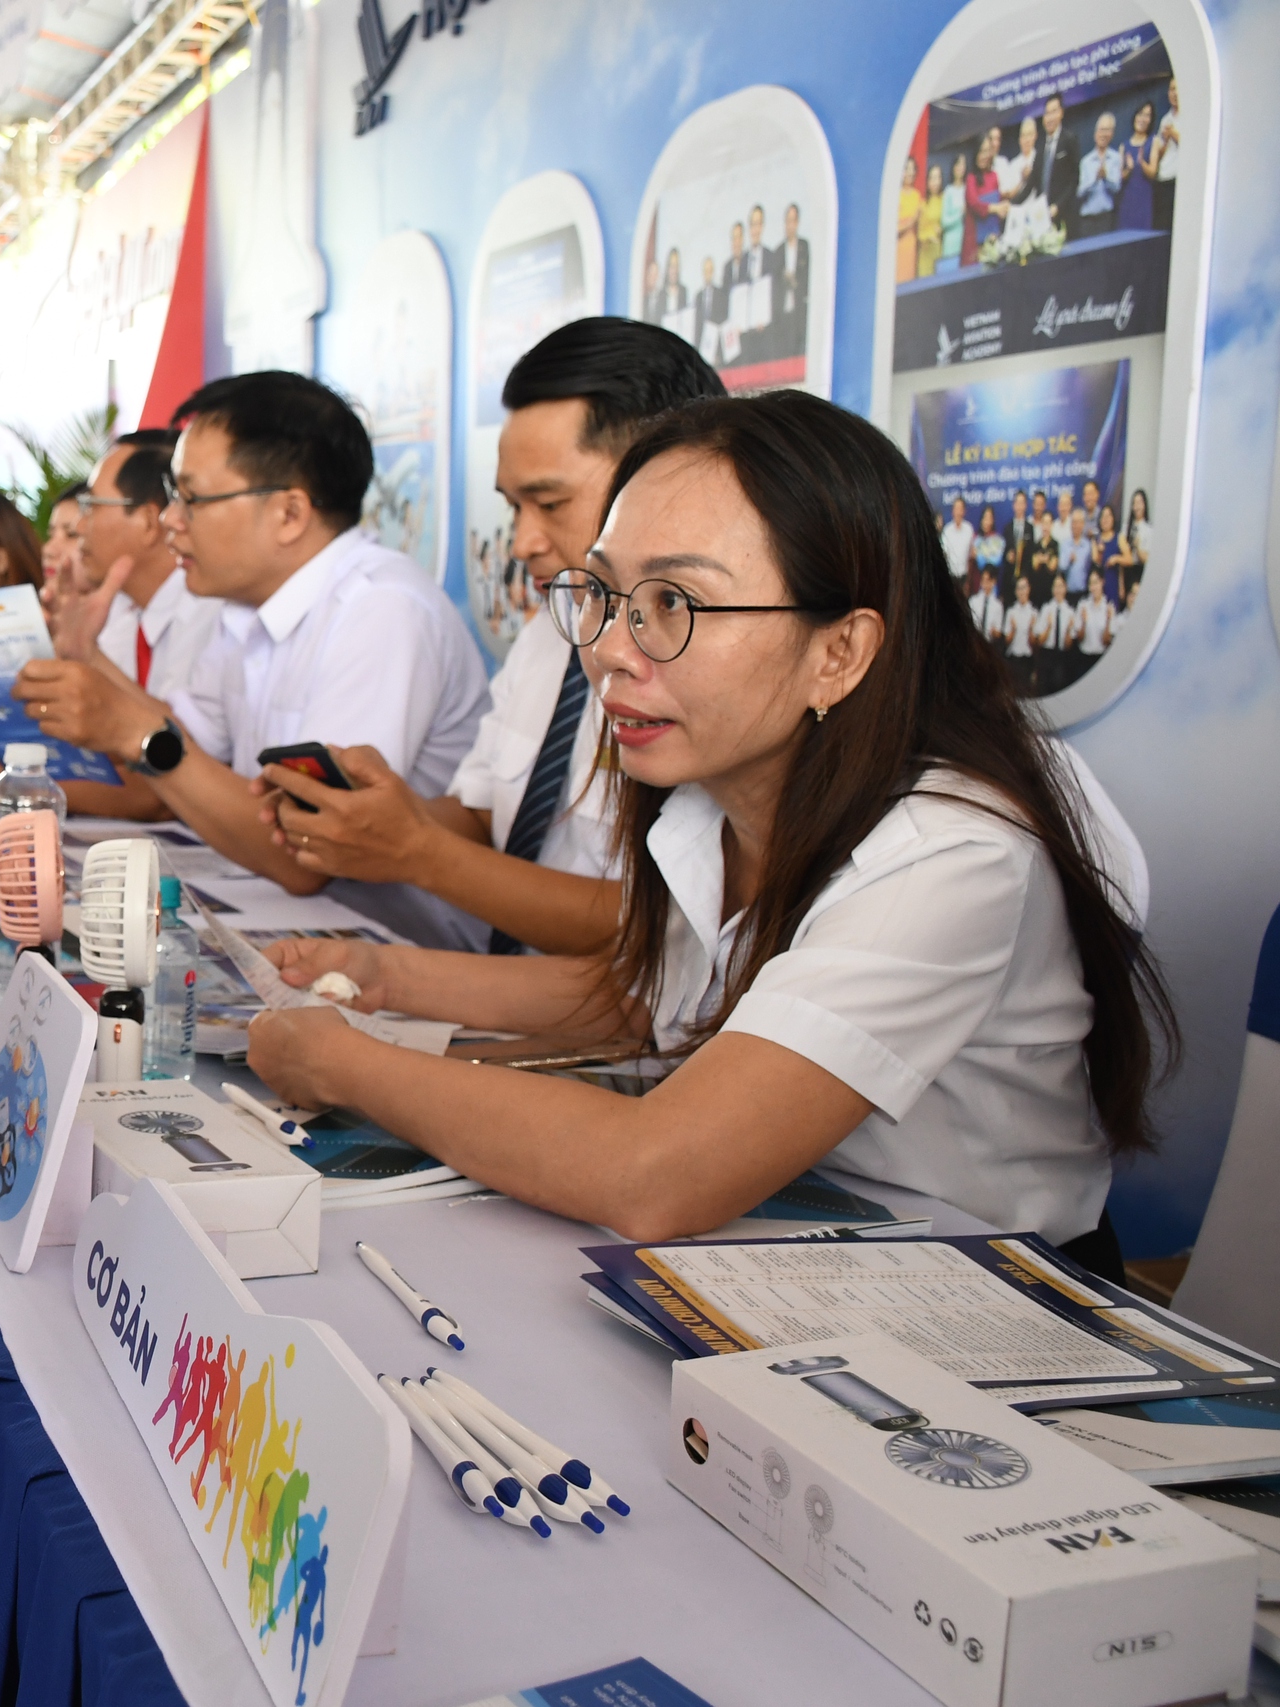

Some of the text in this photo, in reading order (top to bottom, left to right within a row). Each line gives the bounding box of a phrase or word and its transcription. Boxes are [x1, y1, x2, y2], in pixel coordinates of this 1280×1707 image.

[633, 1279, 673, 1297] QUY
[87, 1240, 159, 1388] CƠ BẢN
[654, 1297, 703, 1322] CHÍNH
[963, 1501, 1163, 1544] LED digital display fan
[1044, 1526, 1136, 1555] FAN
